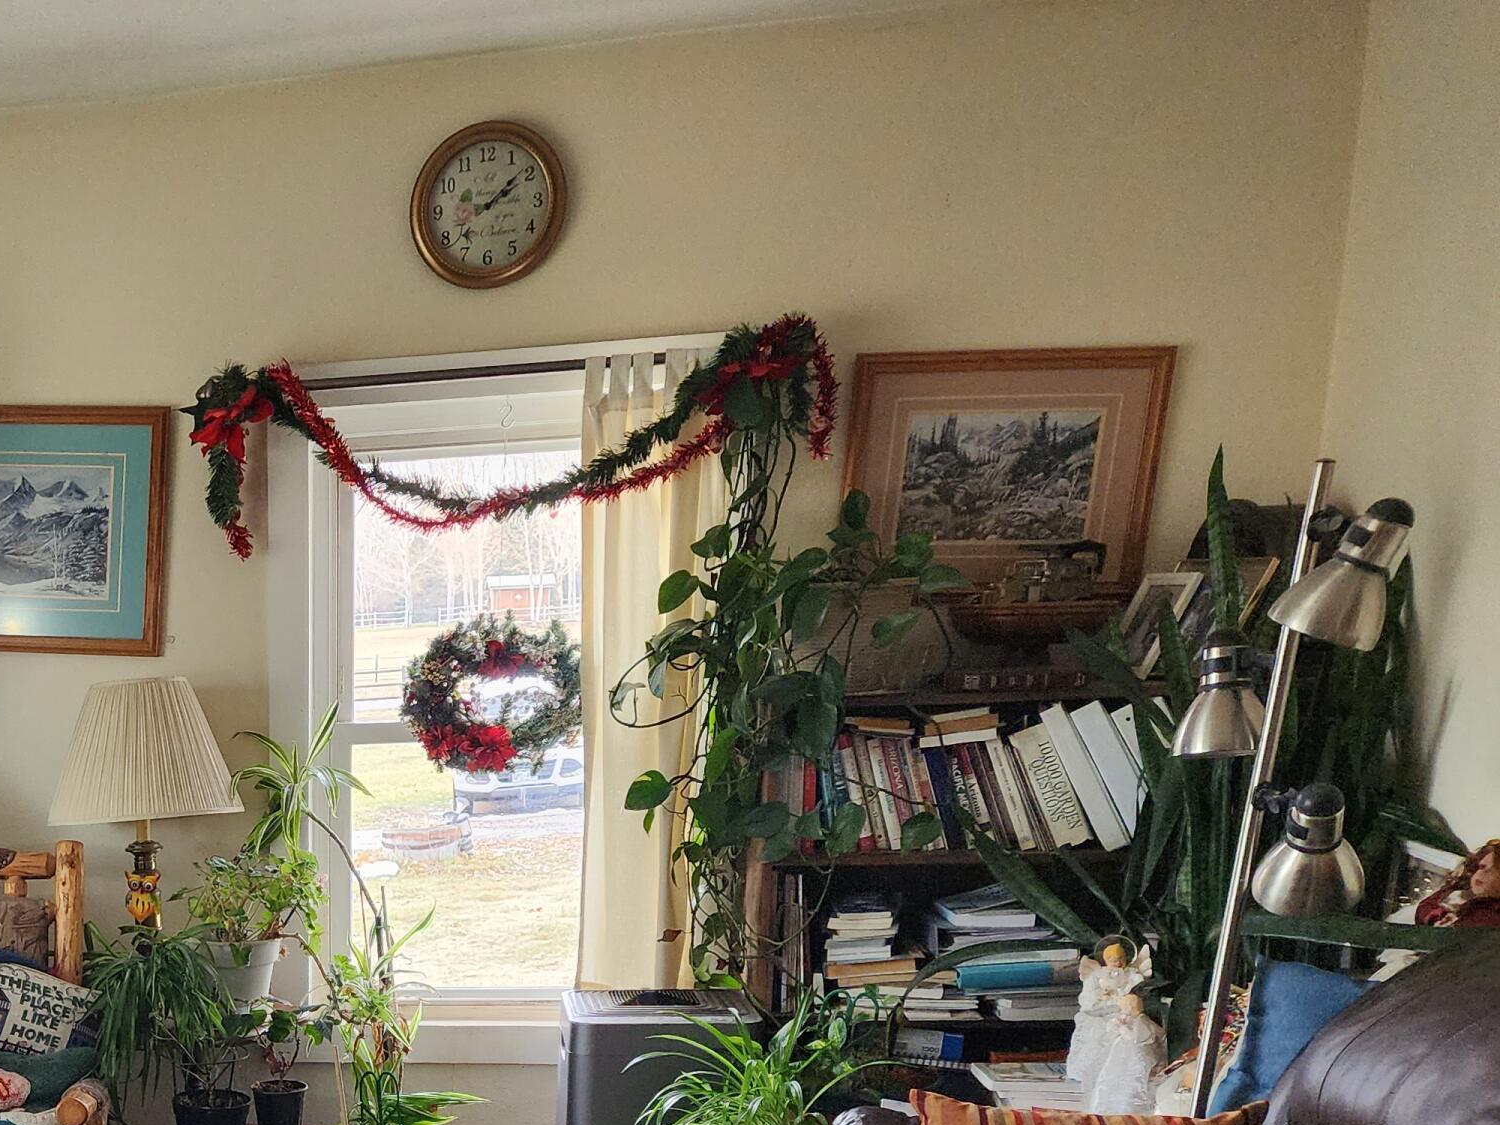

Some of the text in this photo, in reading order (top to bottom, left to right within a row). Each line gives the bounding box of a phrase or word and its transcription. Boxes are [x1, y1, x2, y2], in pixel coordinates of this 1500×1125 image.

[479, 147, 496, 163] 12
[508, 151, 516, 166] 1
[458, 157, 471, 173] 11
[525, 166, 535, 182] 2
[441, 177, 455, 194] 10
[533, 192, 543, 208] 3
[433, 205, 443, 221] 9
[526, 218, 536, 234] 4
[441, 230, 451, 246] 8
[460, 247, 470, 262] 7
[507, 240, 517, 256] 5
[482, 250, 493, 265] 6
[1030, 758, 1066, 823] QUESTIONS
[967, 782, 983, 818] Arizona
[1053, 780, 1084, 830] GARDEN
[0, 974, 65, 1003] THERE'S
[19, 992, 72, 1019] PLACE
[21, 1009, 61, 1031] LIKE
[9, 1023, 61, 1048] HOME
